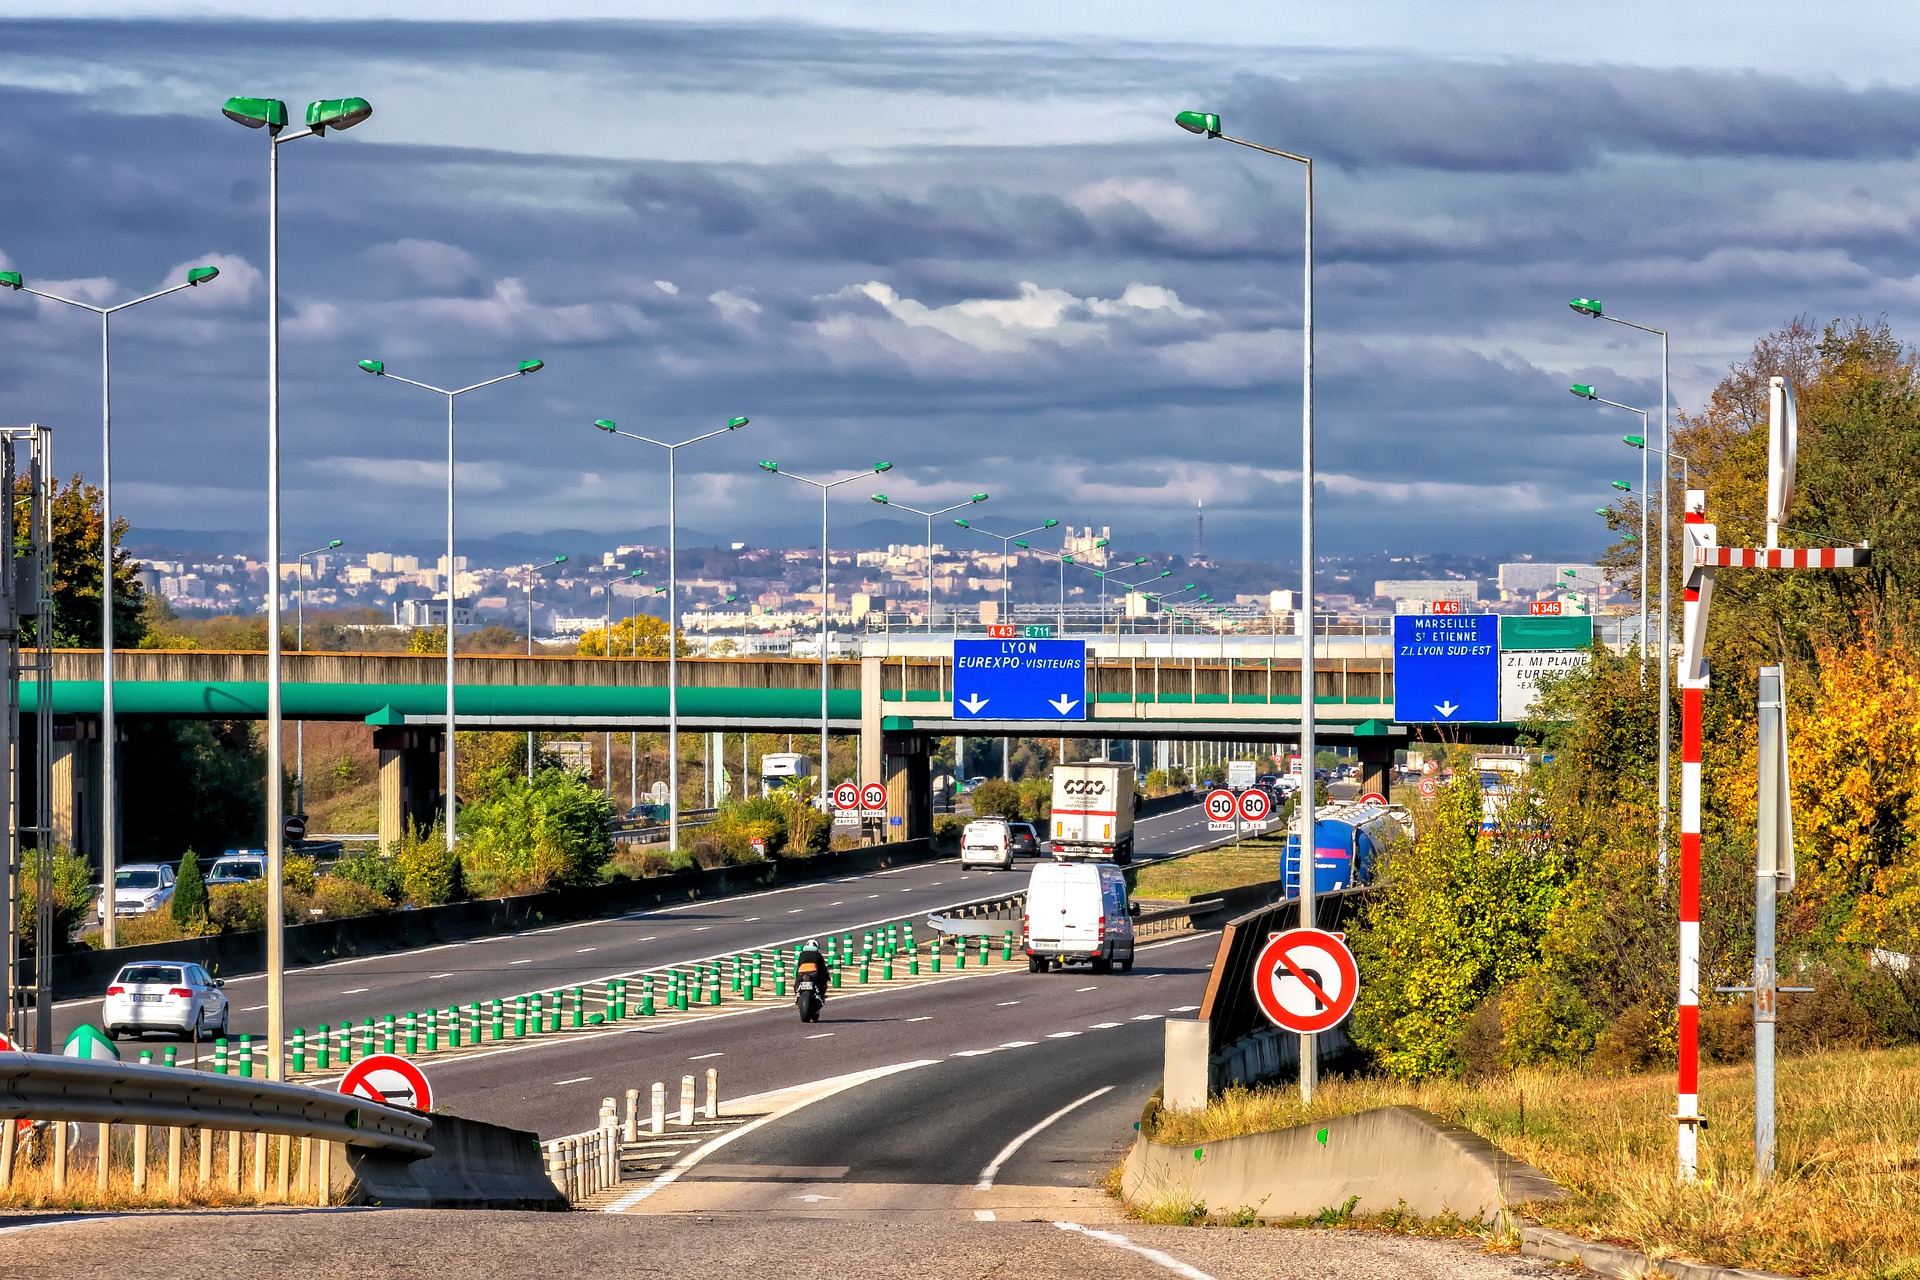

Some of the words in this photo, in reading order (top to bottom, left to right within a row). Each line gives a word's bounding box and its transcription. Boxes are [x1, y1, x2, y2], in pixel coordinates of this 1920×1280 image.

[1434, 602, 1441, 612] A
[1443, 602, 1458, 612] 46
[1532, 603, 1539, 613] N
[1541, 603, 1560, 613] 346
[1415, 619, 1477, 628] MARSEILLE
[989, 627, 996, 636] A
[998, 627, 1013, 636] 43
[1025, 627, 1031, 636] E
[1034, 627, 1049, 636] 711
[1432, 632, 1477, 641] ETIENNE
[1001, 642, 1037, 653] LYON
[1400, 646, 1415, 656] Z.I.
[1417, 646, 1444, 656] LYON
[1447, 645, 1492, 656] SUD-EST
[1507, 657, 1524, 667] Z.I.
[1529, 657, 1543, 667] MI
[1547, 656, 1587, 667] PLAINE
[839, 791, 855, 802] 80
[866, 791, 882, 802] 90
[1212, 800, 1231, 812] 90
[1245, 799, 1263, 811] 80
